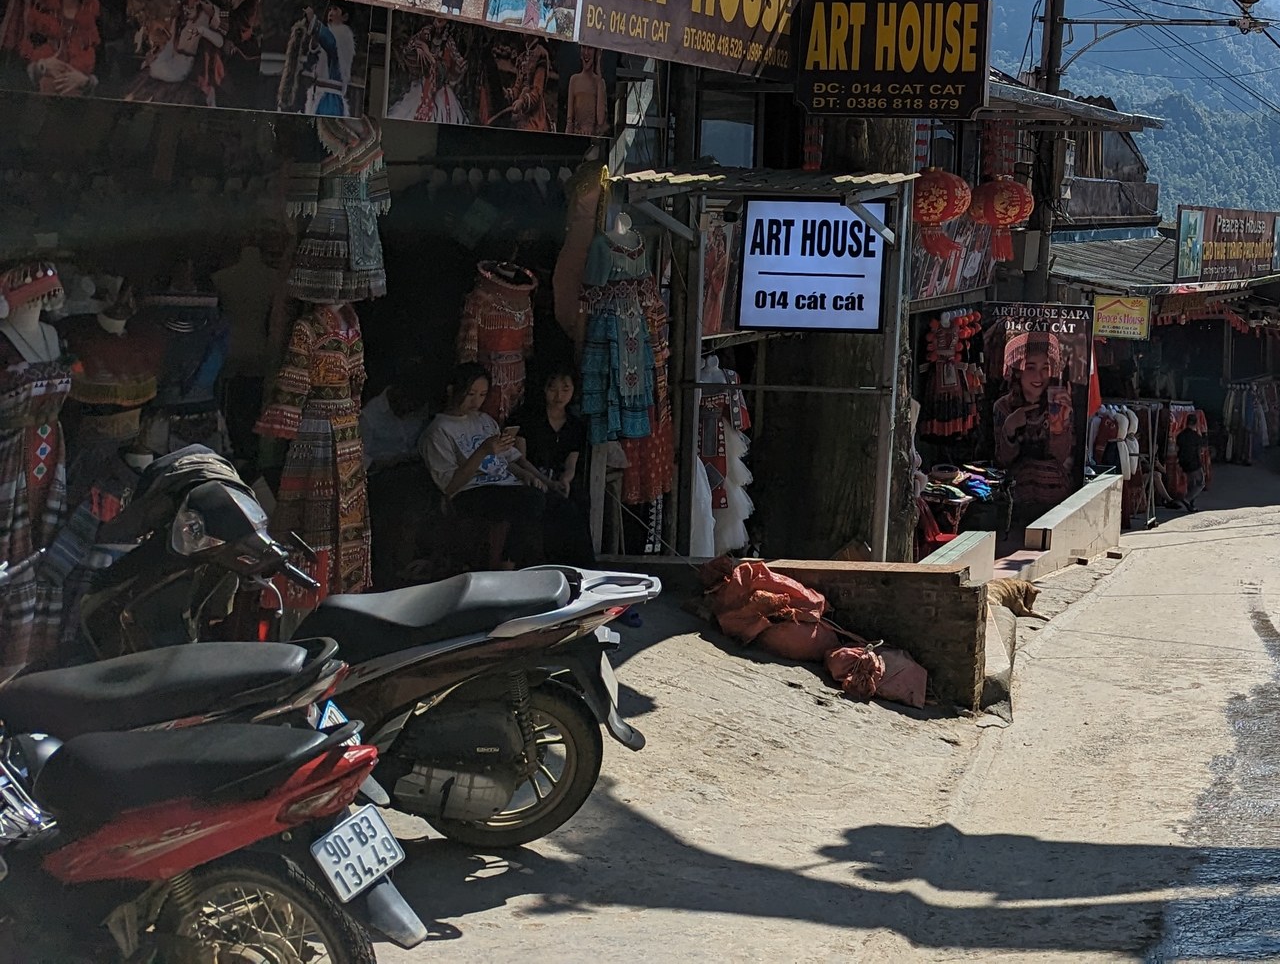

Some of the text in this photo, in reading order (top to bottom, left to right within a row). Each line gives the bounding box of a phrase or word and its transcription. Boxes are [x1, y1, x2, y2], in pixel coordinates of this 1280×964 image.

[610, 11, 627, 35] 014
[629, 15, 649, 39] CAT
[651, 20, 670, 43] CAT
[717, 35, 729, 56] 418
[729, 38, 743, 60] 528
[804, 1, 979, 73] ART HOUSE
[812, 82, 966, 96] ĐC: 014 CAT CAT
[812, 97, 960, 110] ĐT: 0386 818 879
[1217, 214, 1265, 233] Peace's House
[750, 219, 876, 258] ART HOUSE
[755, 290, 864, 311] 014 cát cát
[992, 306, 1091, 320] ART HOUSE SAPA
[1097, 312, 1144, 325] Peace's House
[1004, 319, 1076, 333] 014 CÁT CÁT
[324, 816, 378, 865] 90-B3
[334, 837, 399, 894] 134.49
